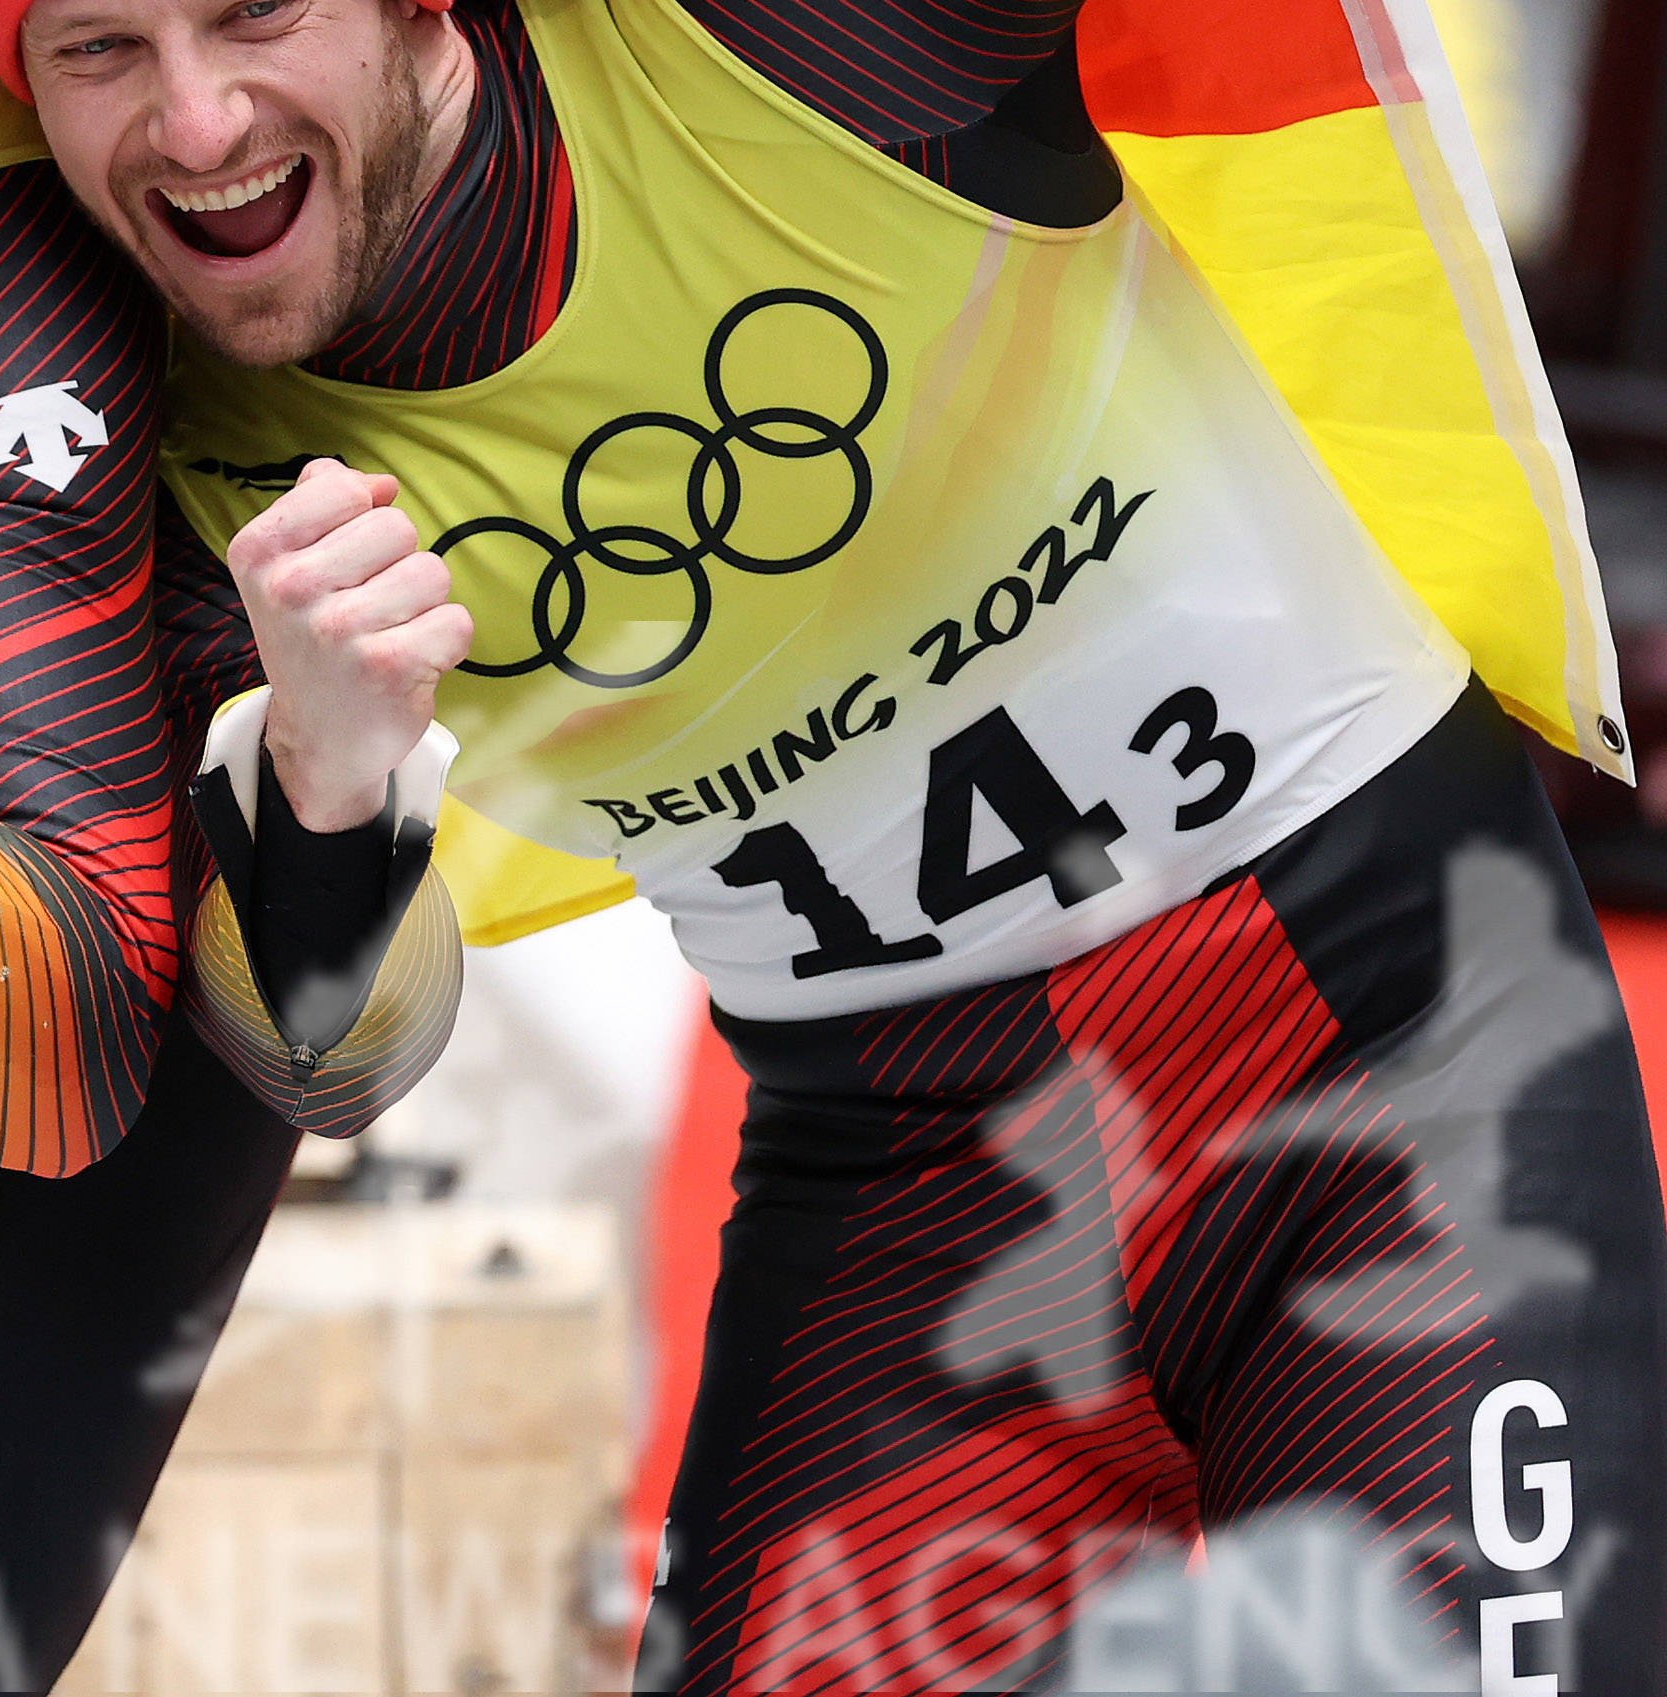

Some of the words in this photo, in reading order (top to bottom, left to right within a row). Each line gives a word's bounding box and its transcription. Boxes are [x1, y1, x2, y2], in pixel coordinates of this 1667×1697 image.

[581, 673, 897, 838] BEIJING
[908, 475, 1157, 686] 2022
[711, 704, 1129, 980] 14
[1127, 685, 1257, 831] 3
